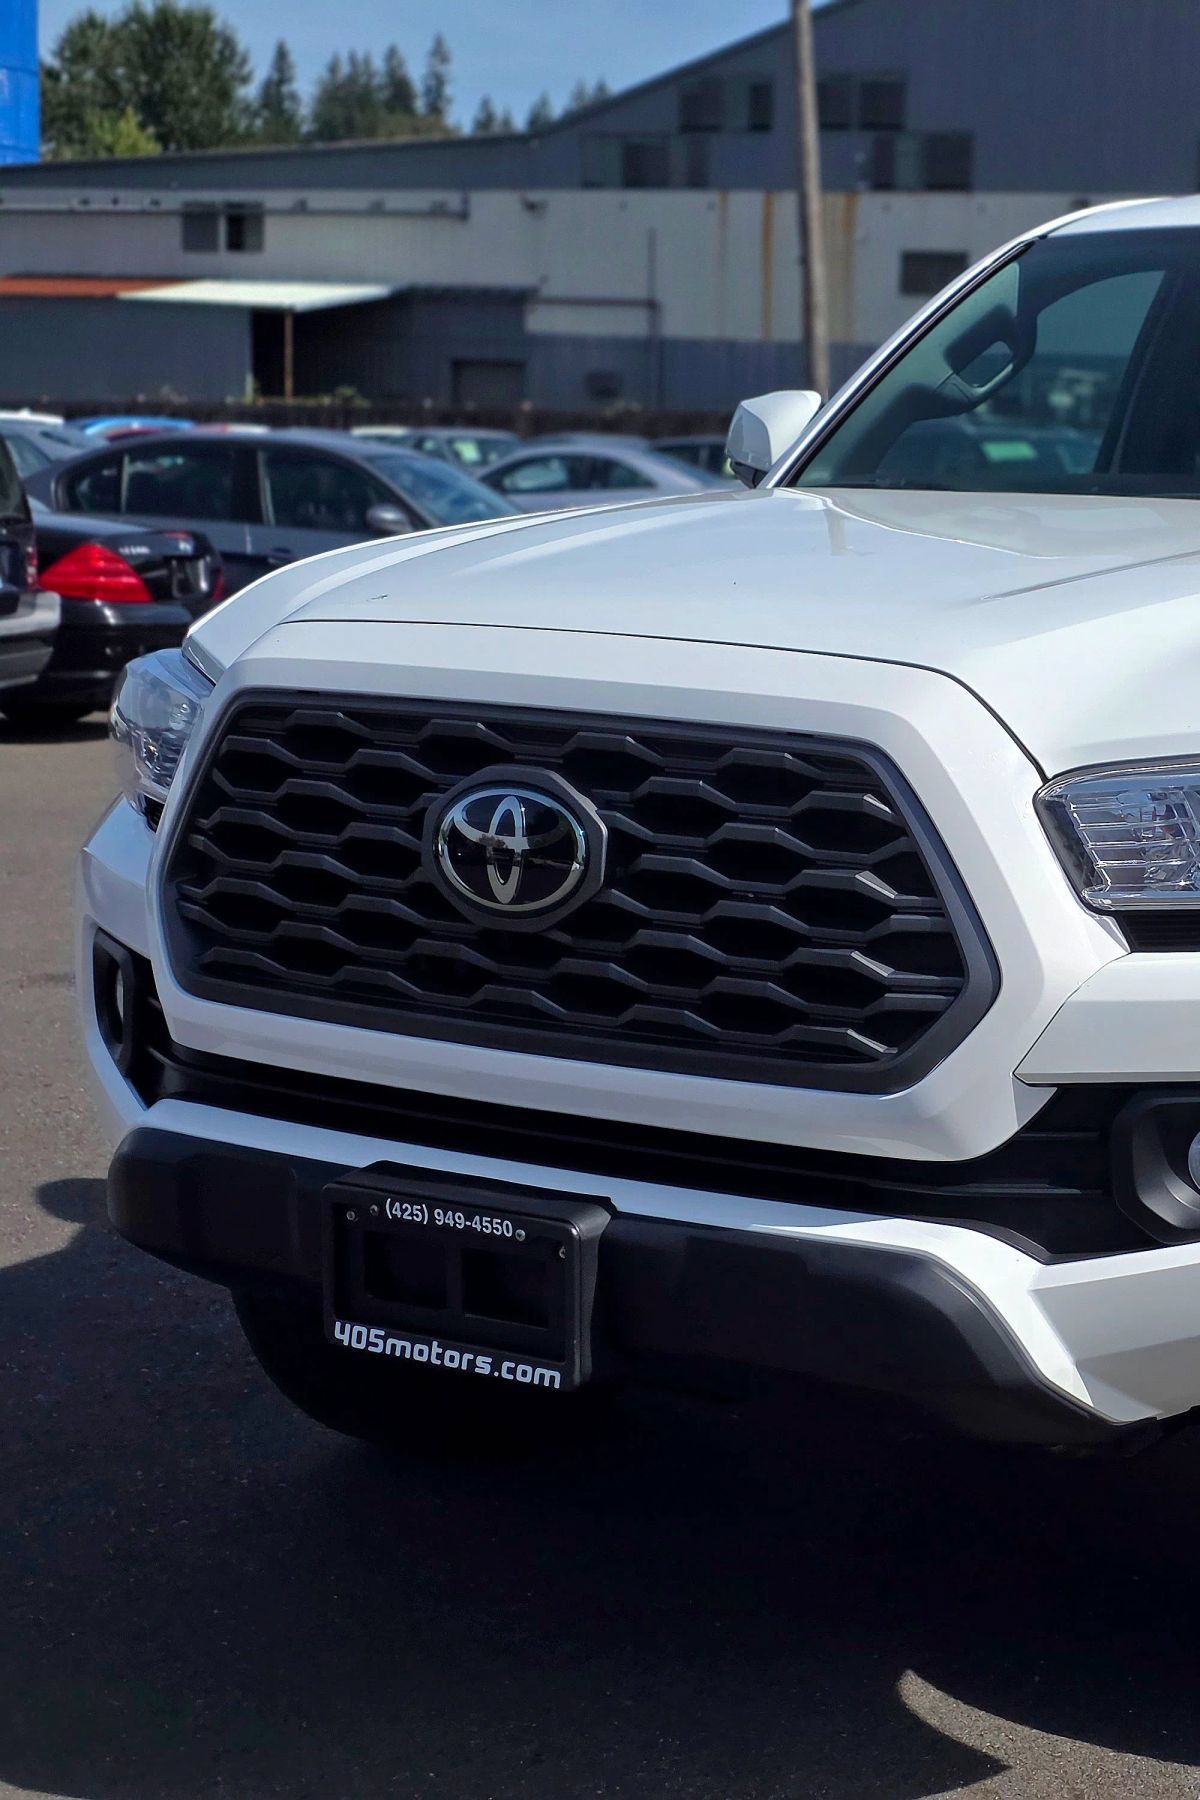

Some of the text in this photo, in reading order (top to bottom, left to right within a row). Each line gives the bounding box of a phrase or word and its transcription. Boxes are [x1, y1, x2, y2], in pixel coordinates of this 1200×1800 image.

[385, 1198, 513, 1238] (425) 949-4550
[334, 1321, 561, 1389] 405motors.com
